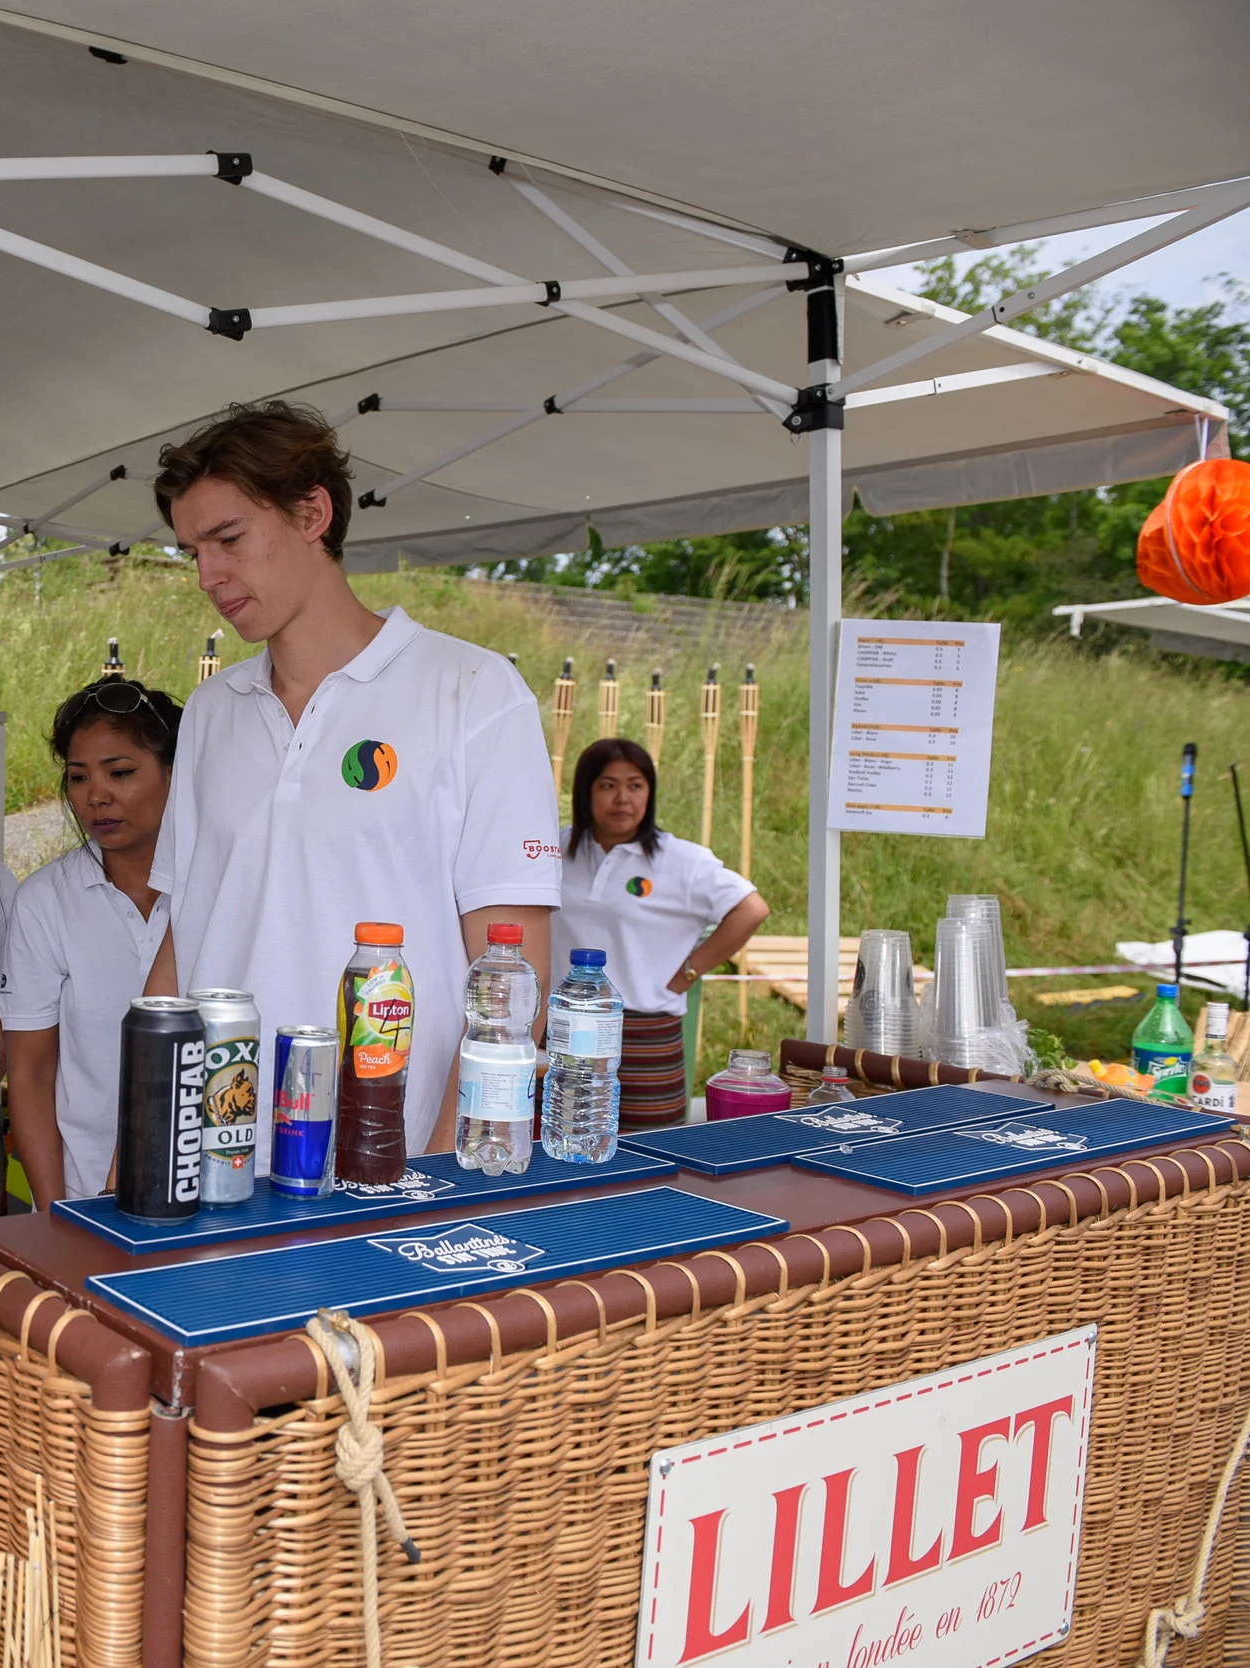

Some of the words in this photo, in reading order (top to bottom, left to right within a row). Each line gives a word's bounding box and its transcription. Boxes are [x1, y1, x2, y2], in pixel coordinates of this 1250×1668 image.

[372, 1004, 410, 1018] Lipton
[358, 1052, 392, 1064] Peach
[1151, 1063, 1188, 1081] Sprite
[175, 1040, 206, 1203] CHOPFAB
[218, 1128, 254, 1145] OLD
[677, 1394, 1074, 1666] LILLET
[935, 1606, 964, 1640] en
[976, 1571, 1023, 1624] 1872
